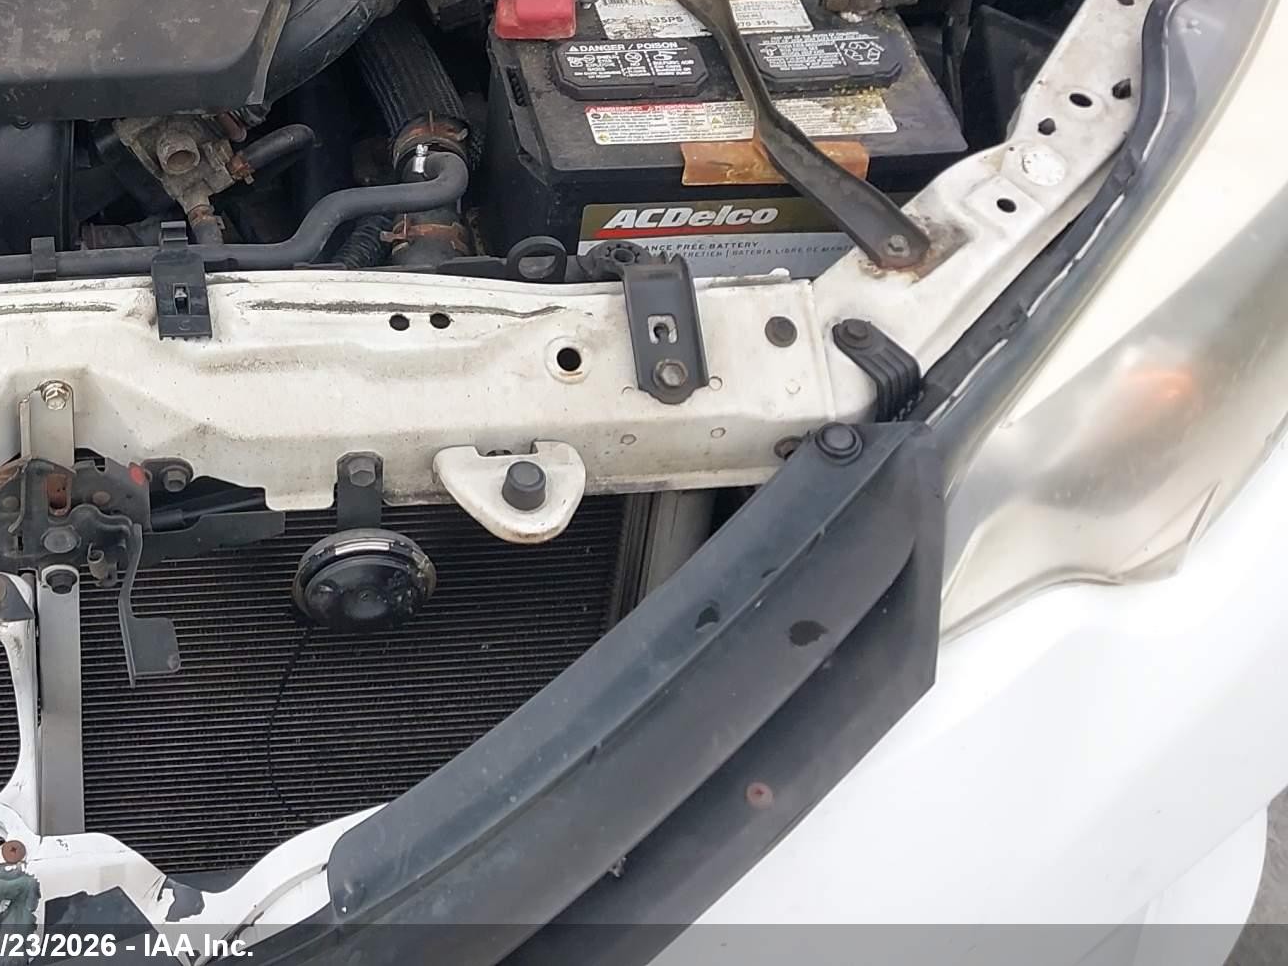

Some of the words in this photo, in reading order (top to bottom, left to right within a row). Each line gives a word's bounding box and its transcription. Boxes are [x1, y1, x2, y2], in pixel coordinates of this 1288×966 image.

[579, 43, 625, 52] DANGER
[636, 41, 679, 50] POISON
[602, 204, 779, 229] ACDelco
[709, 241, 760, 250] BATTERY
